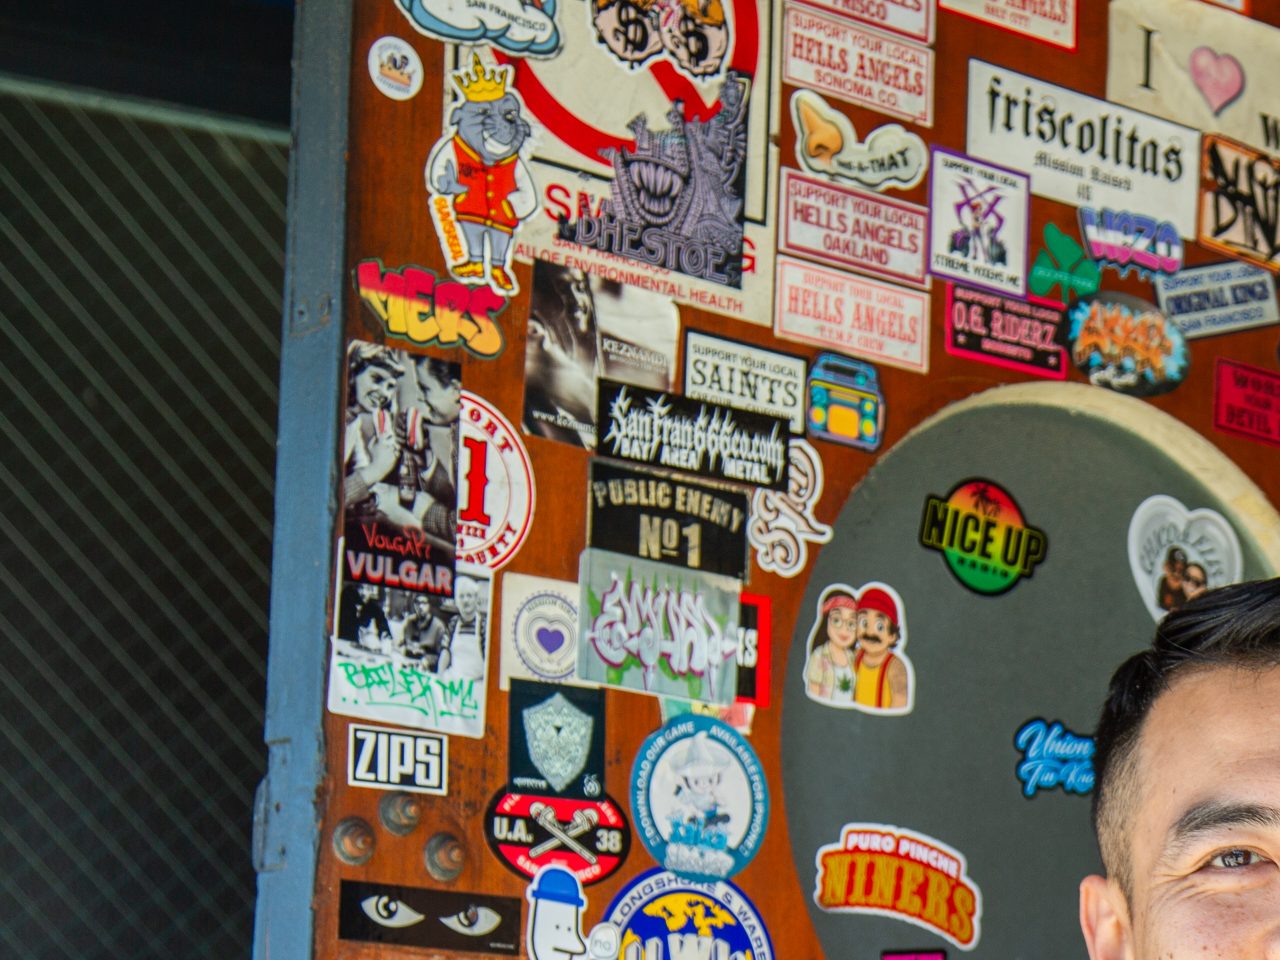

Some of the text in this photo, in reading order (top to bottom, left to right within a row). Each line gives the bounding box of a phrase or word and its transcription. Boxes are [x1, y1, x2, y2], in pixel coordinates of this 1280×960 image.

[488, 2, 547, 31] FRANCISCO
[792, 14, 924, 67] SUPPORT YOUR LOCAL
[791, 32, 924, 97] HELLS ANGELS
[1138, 25, 1159, 91] I
[814, 69, 873, 98] SONOMA
[986, 75, 1184, 182] friscolitas
[790, 179, 922, 230] SUPPORT YOUR LOCAL
[792, 200, 918, 254] HELLS ANGELS
[823, 234, 889, 266] OAKLAND
[564, 255, 686, 298] ENVIRONMENTAL
[689, 288, 744, 313] HEALTH
[788, 284, 919, 344] HELLS ANGELS
[1180, 307, 1264, 332] SAN FRANCISCO
[691, 358, 799, 407] SAINTS
[692, 344, 799, 378] SUPPORT YOUR LOCAL
[1226, 403, 1273, 436] DEVIL
[620, 437, 771, 485] BAY AREA METAL
[592, 477, 744, 533] PUBLIC ENEMY
[923, 500, 1045, 574] NICE UP
[346, 549, 453, 596] VULGAR
[665, 721, 695, 741] GAME
[355, 731, 440, 788] ZIPS
[596, 829, 623, 853] 38
[847, 832, 959, 877] PURO PINCHE
